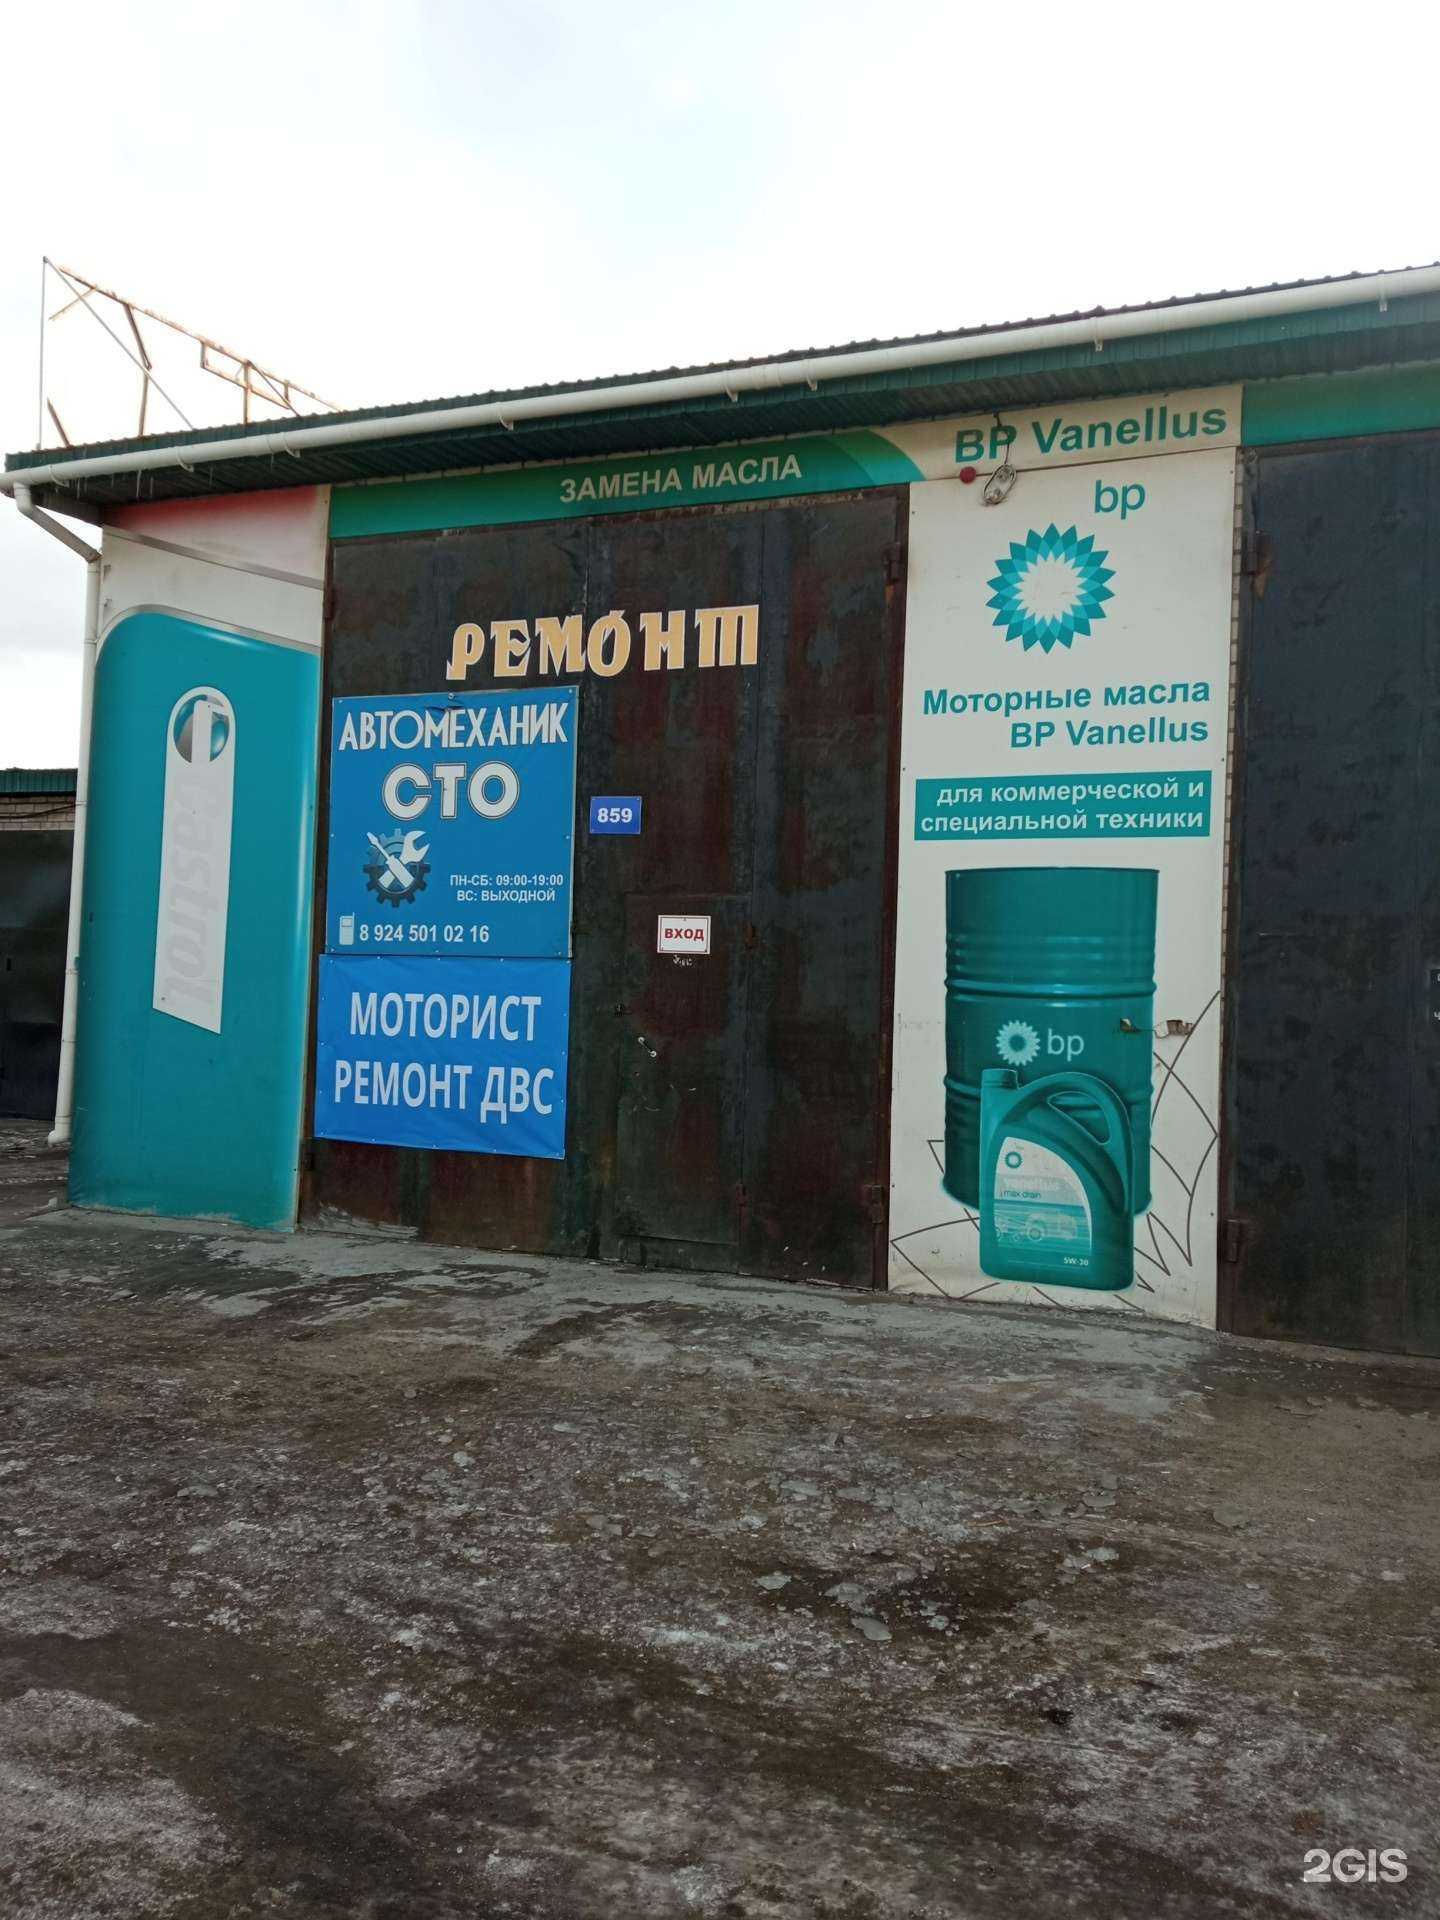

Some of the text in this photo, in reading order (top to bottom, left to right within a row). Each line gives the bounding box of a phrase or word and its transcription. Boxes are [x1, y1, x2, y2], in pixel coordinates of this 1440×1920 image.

[955, 406, 1227, 463] BP Vanellus
[560, 454, 802, 503] ЗАМЕНА МАСЛА
[1094, 480, 1146, 520] bp
[446, 604, 759, 680] РЕМОНТ
[923, 681, 1210, 717] Моторные масла
[338, 702, 569, 751] АВТОМЕХАНИК
[1011, 717, 1209, 748] BP Vanellus
[382, 761, 520, 821] СТО
[937, 777, 1204, 806] для коммерческой и
[597, 808, 633, 823] 859
[921, 810, 1203, 834] специальной техники
[450, 874, 564, 887] ПН-СБ: 09:00-19:00
[457, 888, 556, 903] ВС: ВЫХОДНОЙ
[359, 925, 490, 942] 8 924 501 02 16
[664, 928, 704, 941] ВХОД
[350, 992, 542, 1041] МОТОРИСТ
[1047, 1028, 1084, 1062] bp
[334, 1060, 554, 1124] РЕМОНТ ДВС
